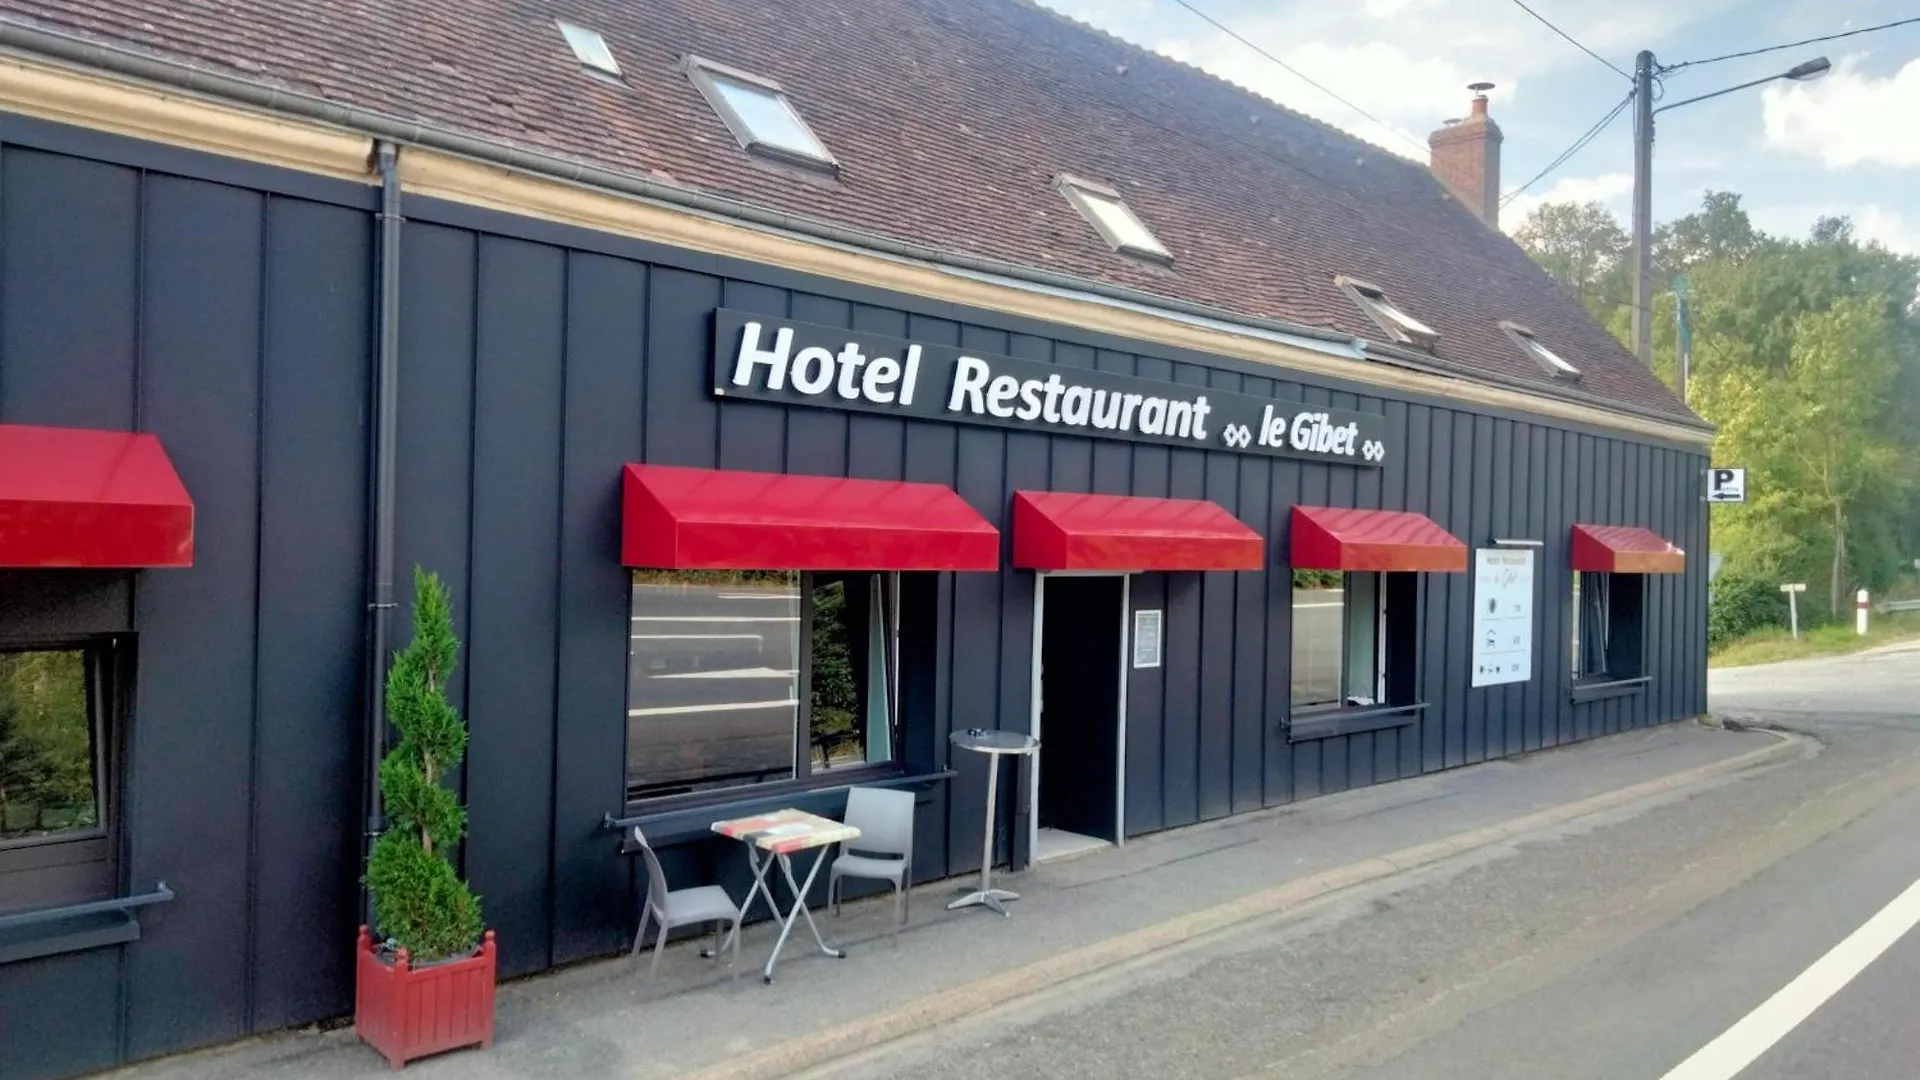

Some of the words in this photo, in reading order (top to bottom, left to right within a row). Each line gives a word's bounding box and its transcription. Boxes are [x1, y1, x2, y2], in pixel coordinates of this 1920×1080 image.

[732, 321, 923, 406] Hotel
[948, 354, 1211, 441] Restaurant
[1258, 404, 1287, 448] le
[1289, 411, 1359, 456] Gibet
[1714, 470, 1734, 491] P
